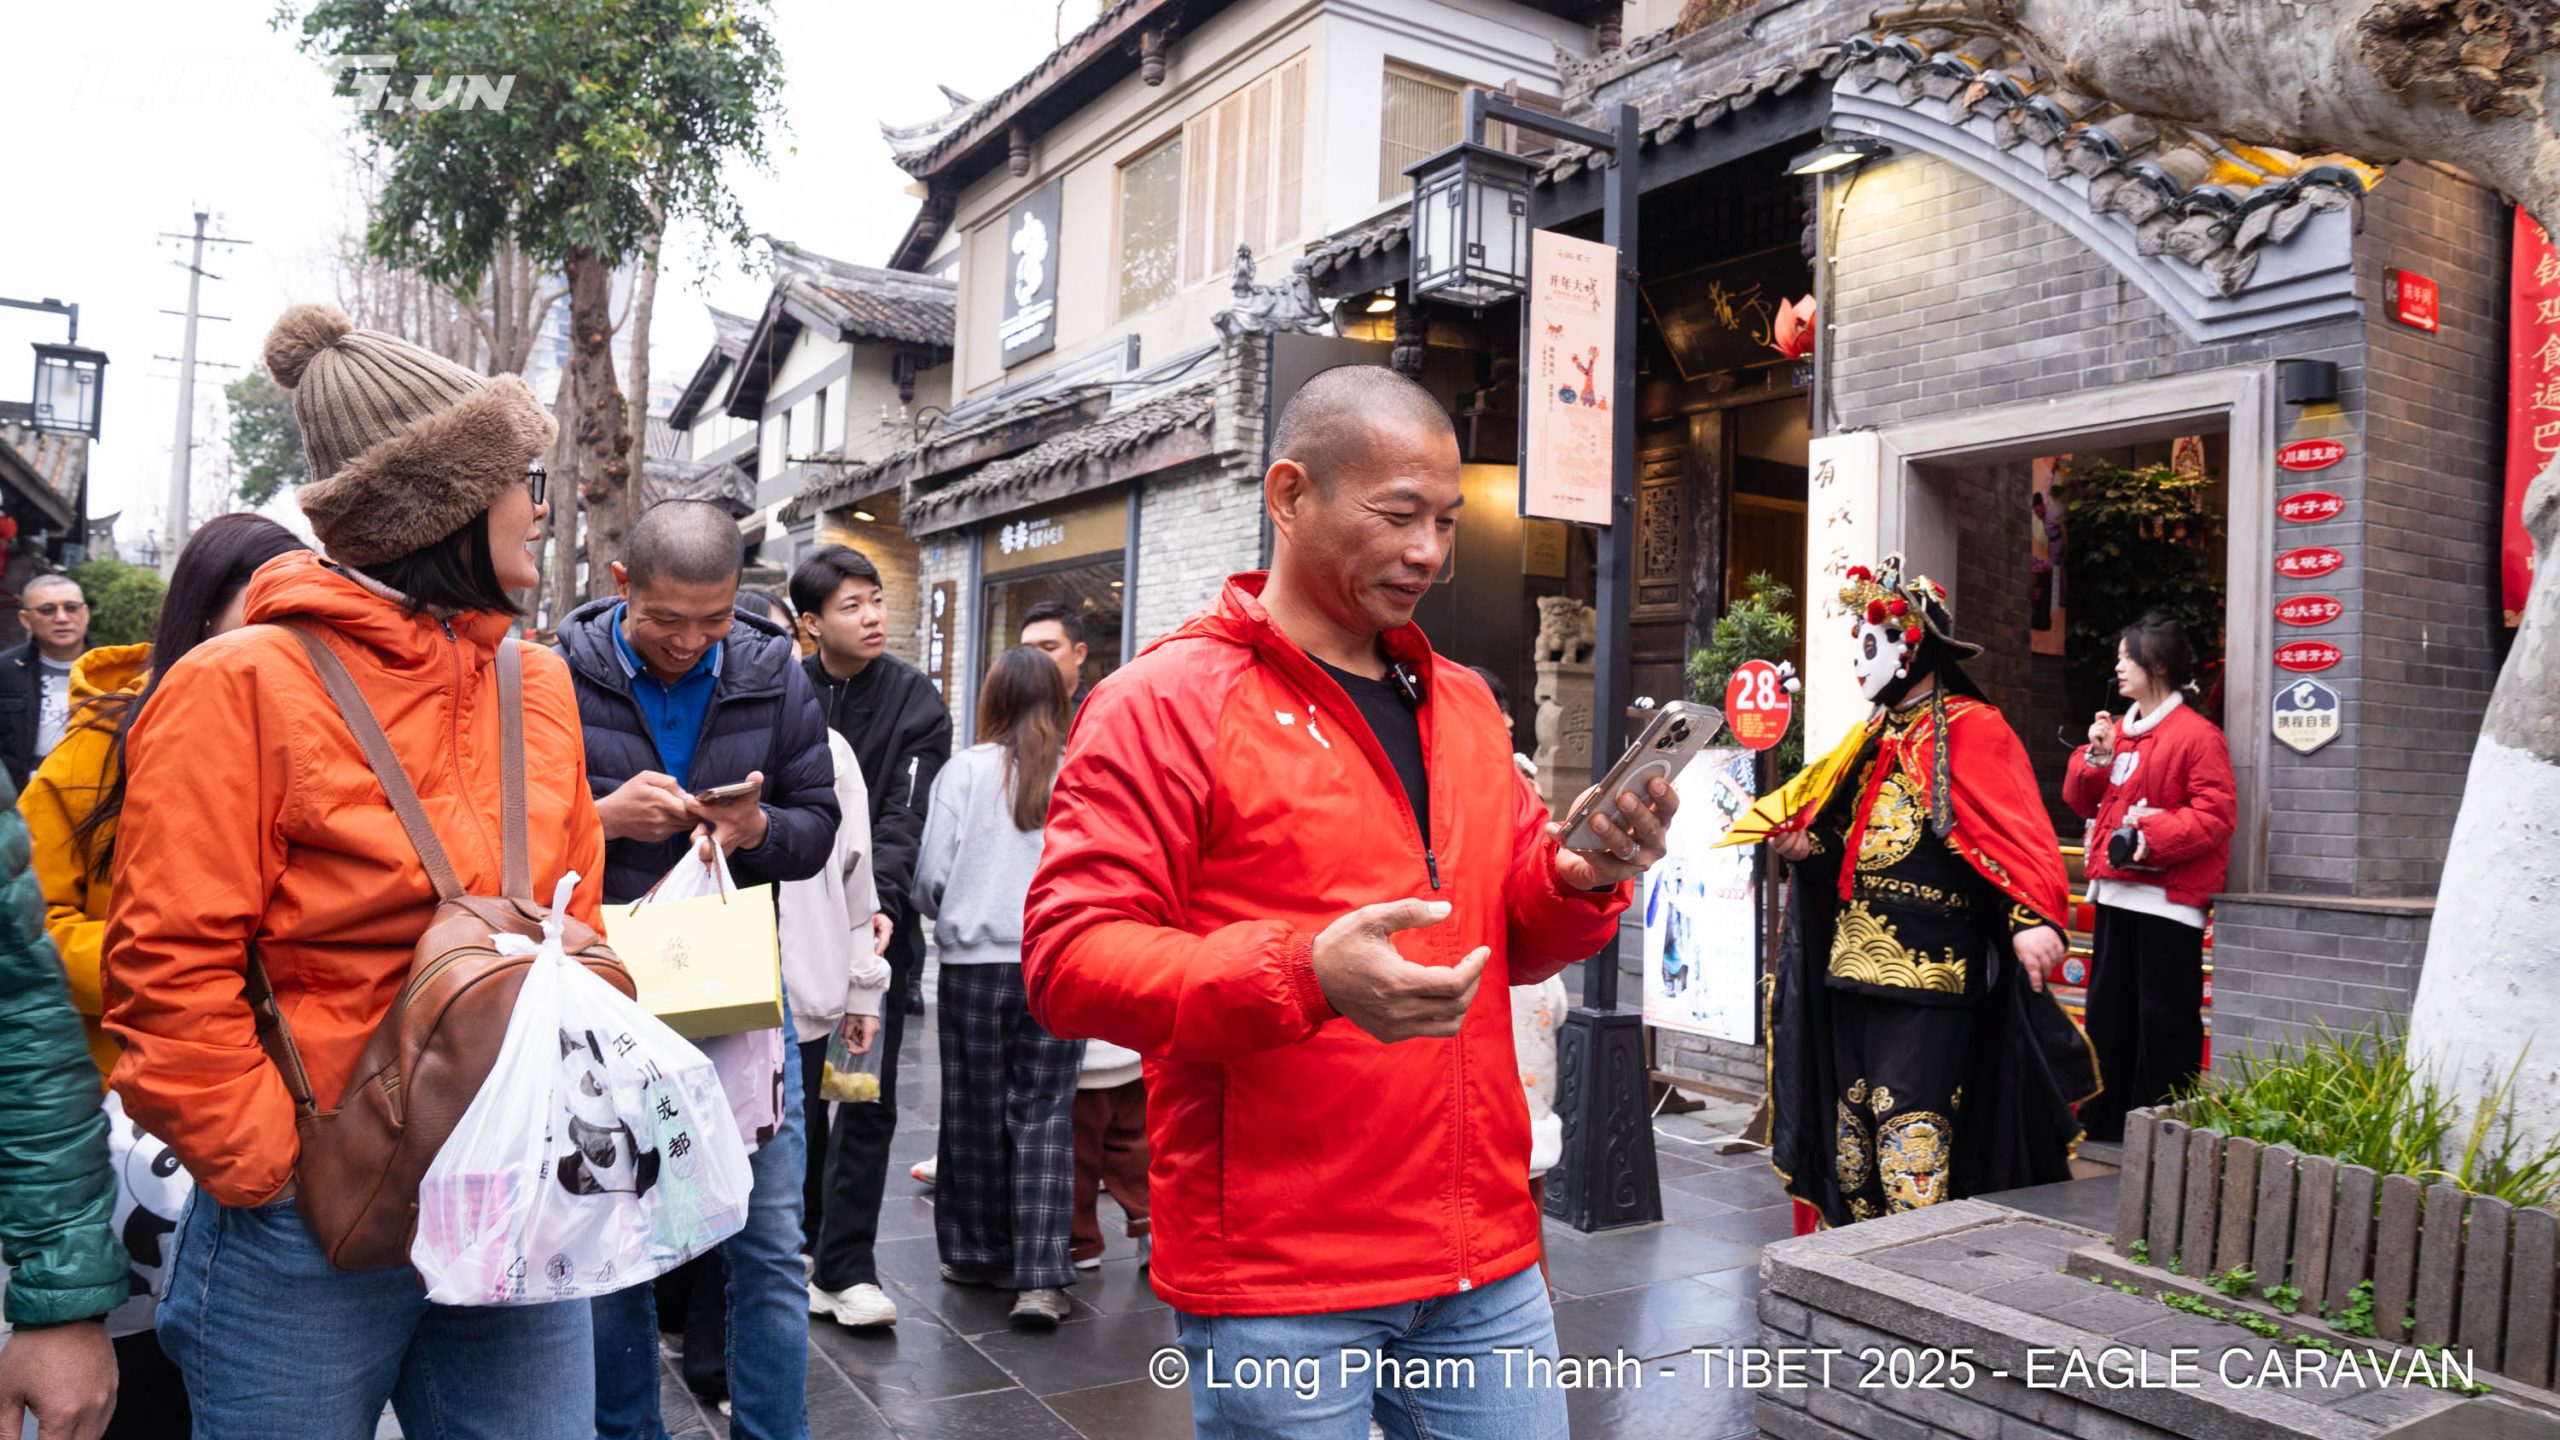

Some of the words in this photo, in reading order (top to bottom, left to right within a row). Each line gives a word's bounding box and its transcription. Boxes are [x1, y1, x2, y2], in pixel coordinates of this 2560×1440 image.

[2283, 500, 2339, 516] 折子戏
[2281, 553, 2337, 570] 盖碗茶
[2282, 603, 2337, 618] 功夫茶艺
[2280, 649, 2336, 662] 空调开放
[1736, 669, 1776, 710] 28
[2278, 714, 2332, 728] 携程自营
